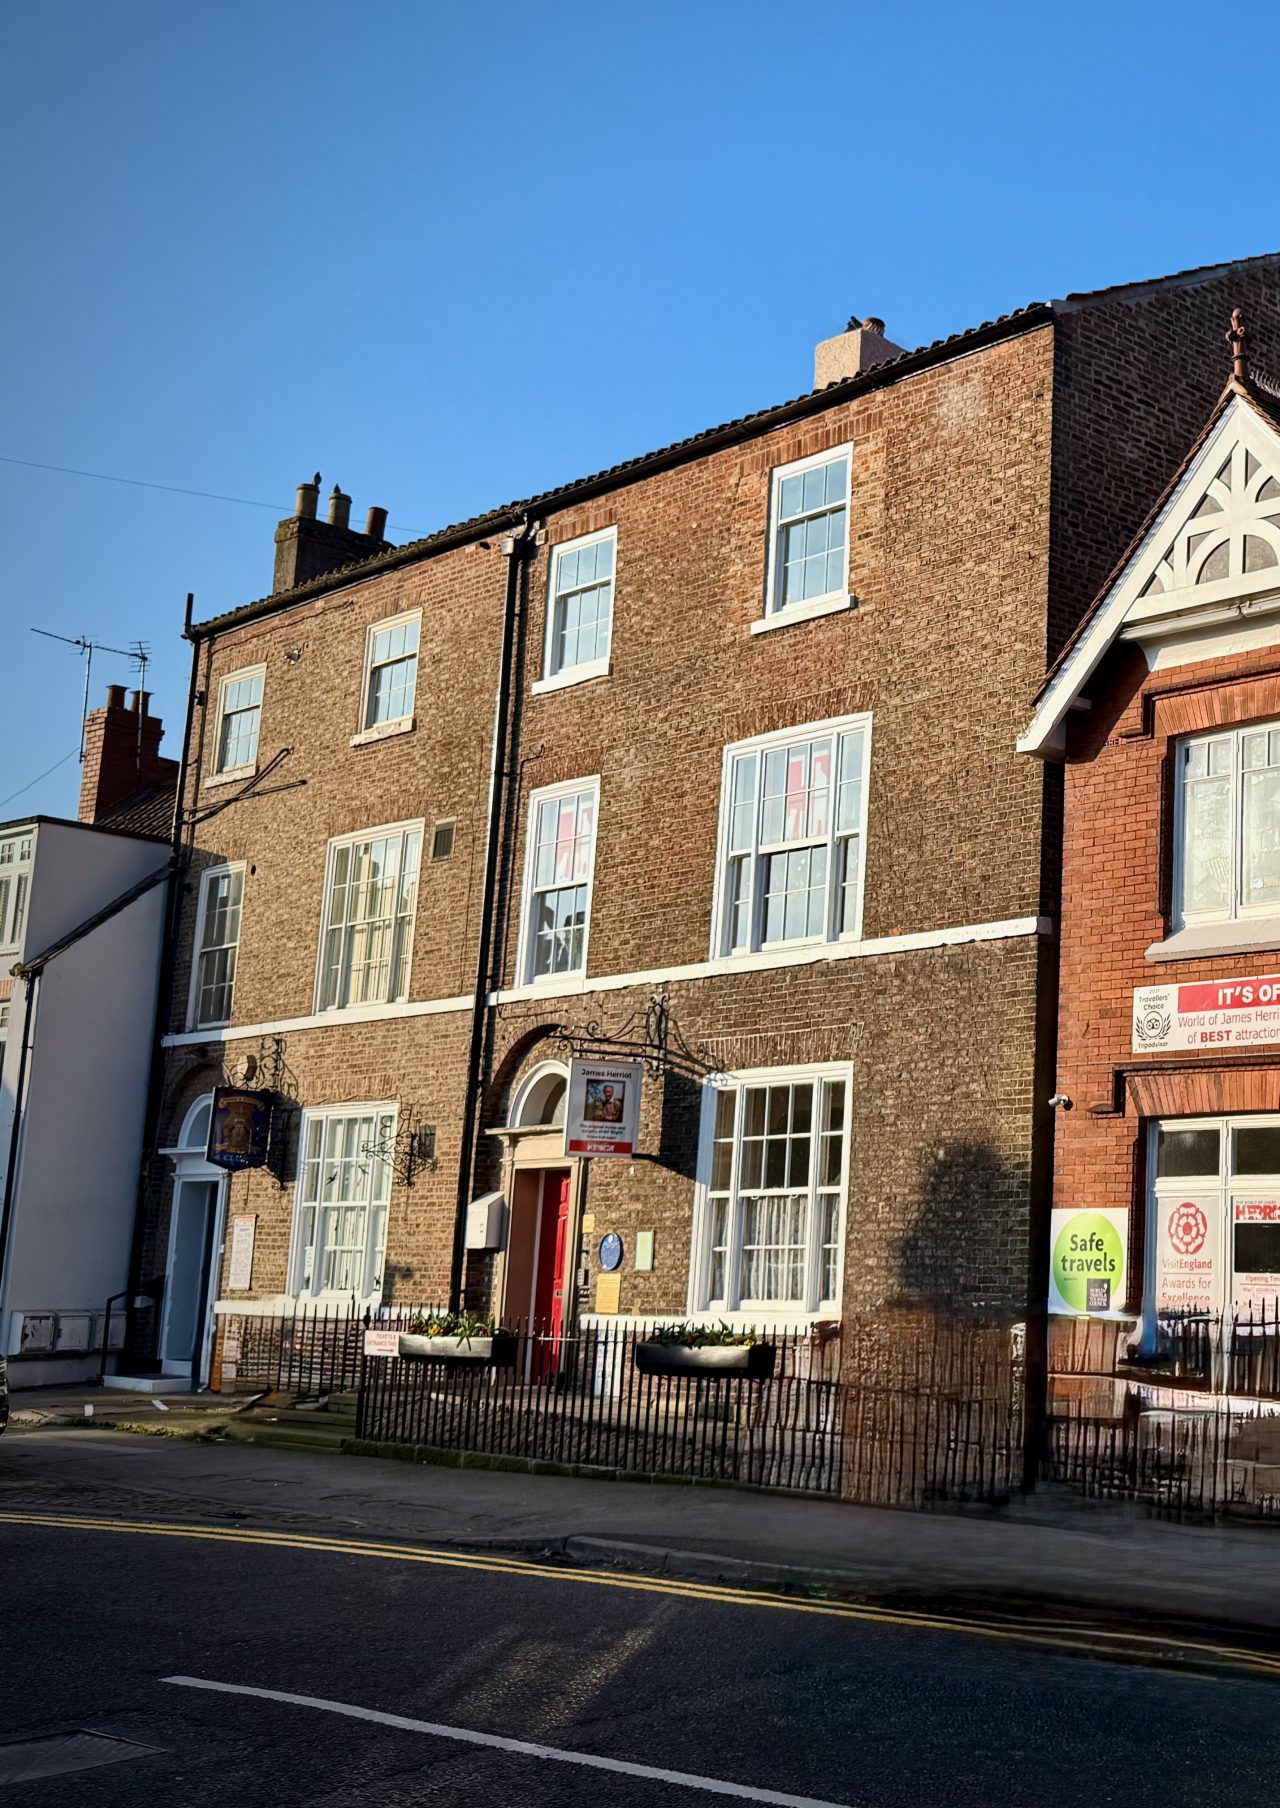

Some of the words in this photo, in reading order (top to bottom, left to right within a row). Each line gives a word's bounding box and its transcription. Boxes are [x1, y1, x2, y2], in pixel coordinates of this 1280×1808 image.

[1218, 985, 1254, 1005] IT'S
[1178, 1014, 1205, 1028] World
[1208, 1013, 1218, 1025] of
[1222, 1012, 1252, 1024] James
[1187, 1032, 1198, 1044] of
[1200, 1030, 1232, 1043] BEST
[1138, 1042, 1169, 1050] Tripadvisor
[581, 1068, 605, 1077] James
[607, 1070, 632, 1079] Herriot
[1070, 1232, 1104, 1251] Safe
[1061, 1252, 1116, 1272] travels
[1162, 1258, 1212, 1271] VisitEngland
[1162, 1278, 1196, 1288] Awards
[1199, 1278, 1211, 1288] for
[1246, 1275, 1268, 1283] Opening
